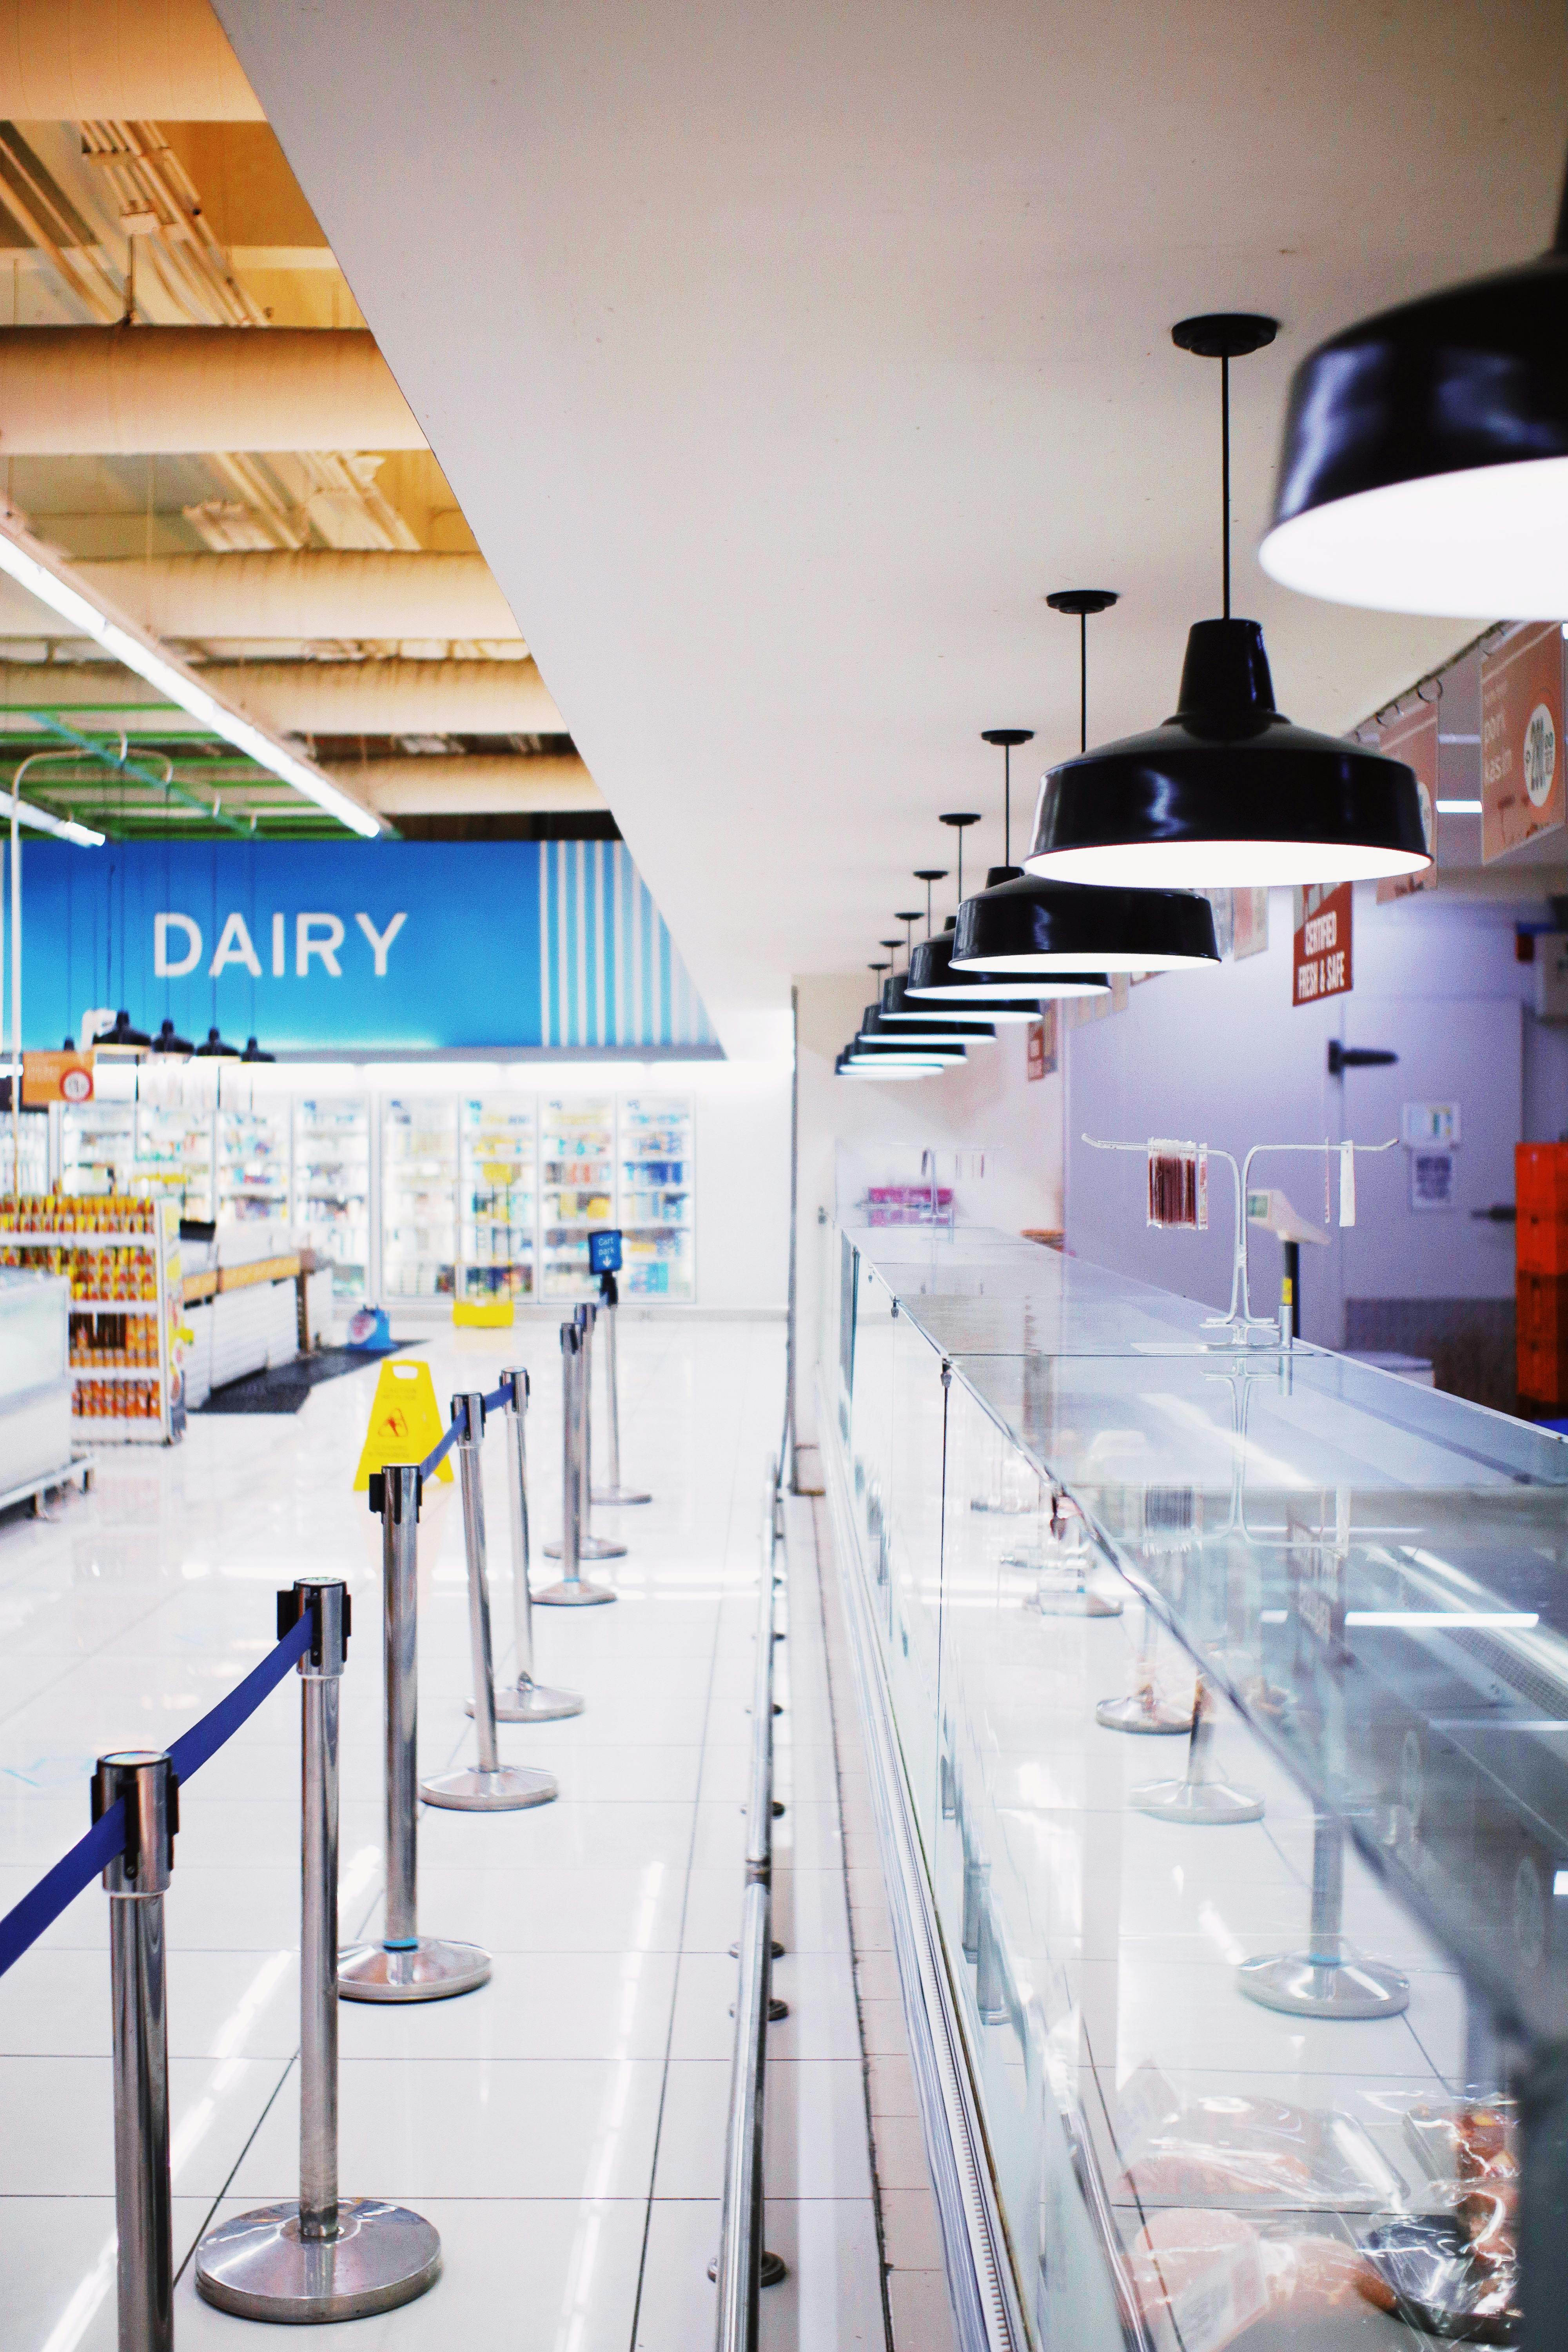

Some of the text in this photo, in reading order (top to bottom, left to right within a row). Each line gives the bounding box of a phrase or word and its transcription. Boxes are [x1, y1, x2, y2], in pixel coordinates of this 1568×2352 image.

[154, 912, 408, 978] DAIRY
[1304, 910, 1337, 956] CERTIFIED
[1298, 951, 1345, 999] FRESH & SAFE
[598, 1237, 613, 1246] Cart
[598, 1247, 614, 1257] park
